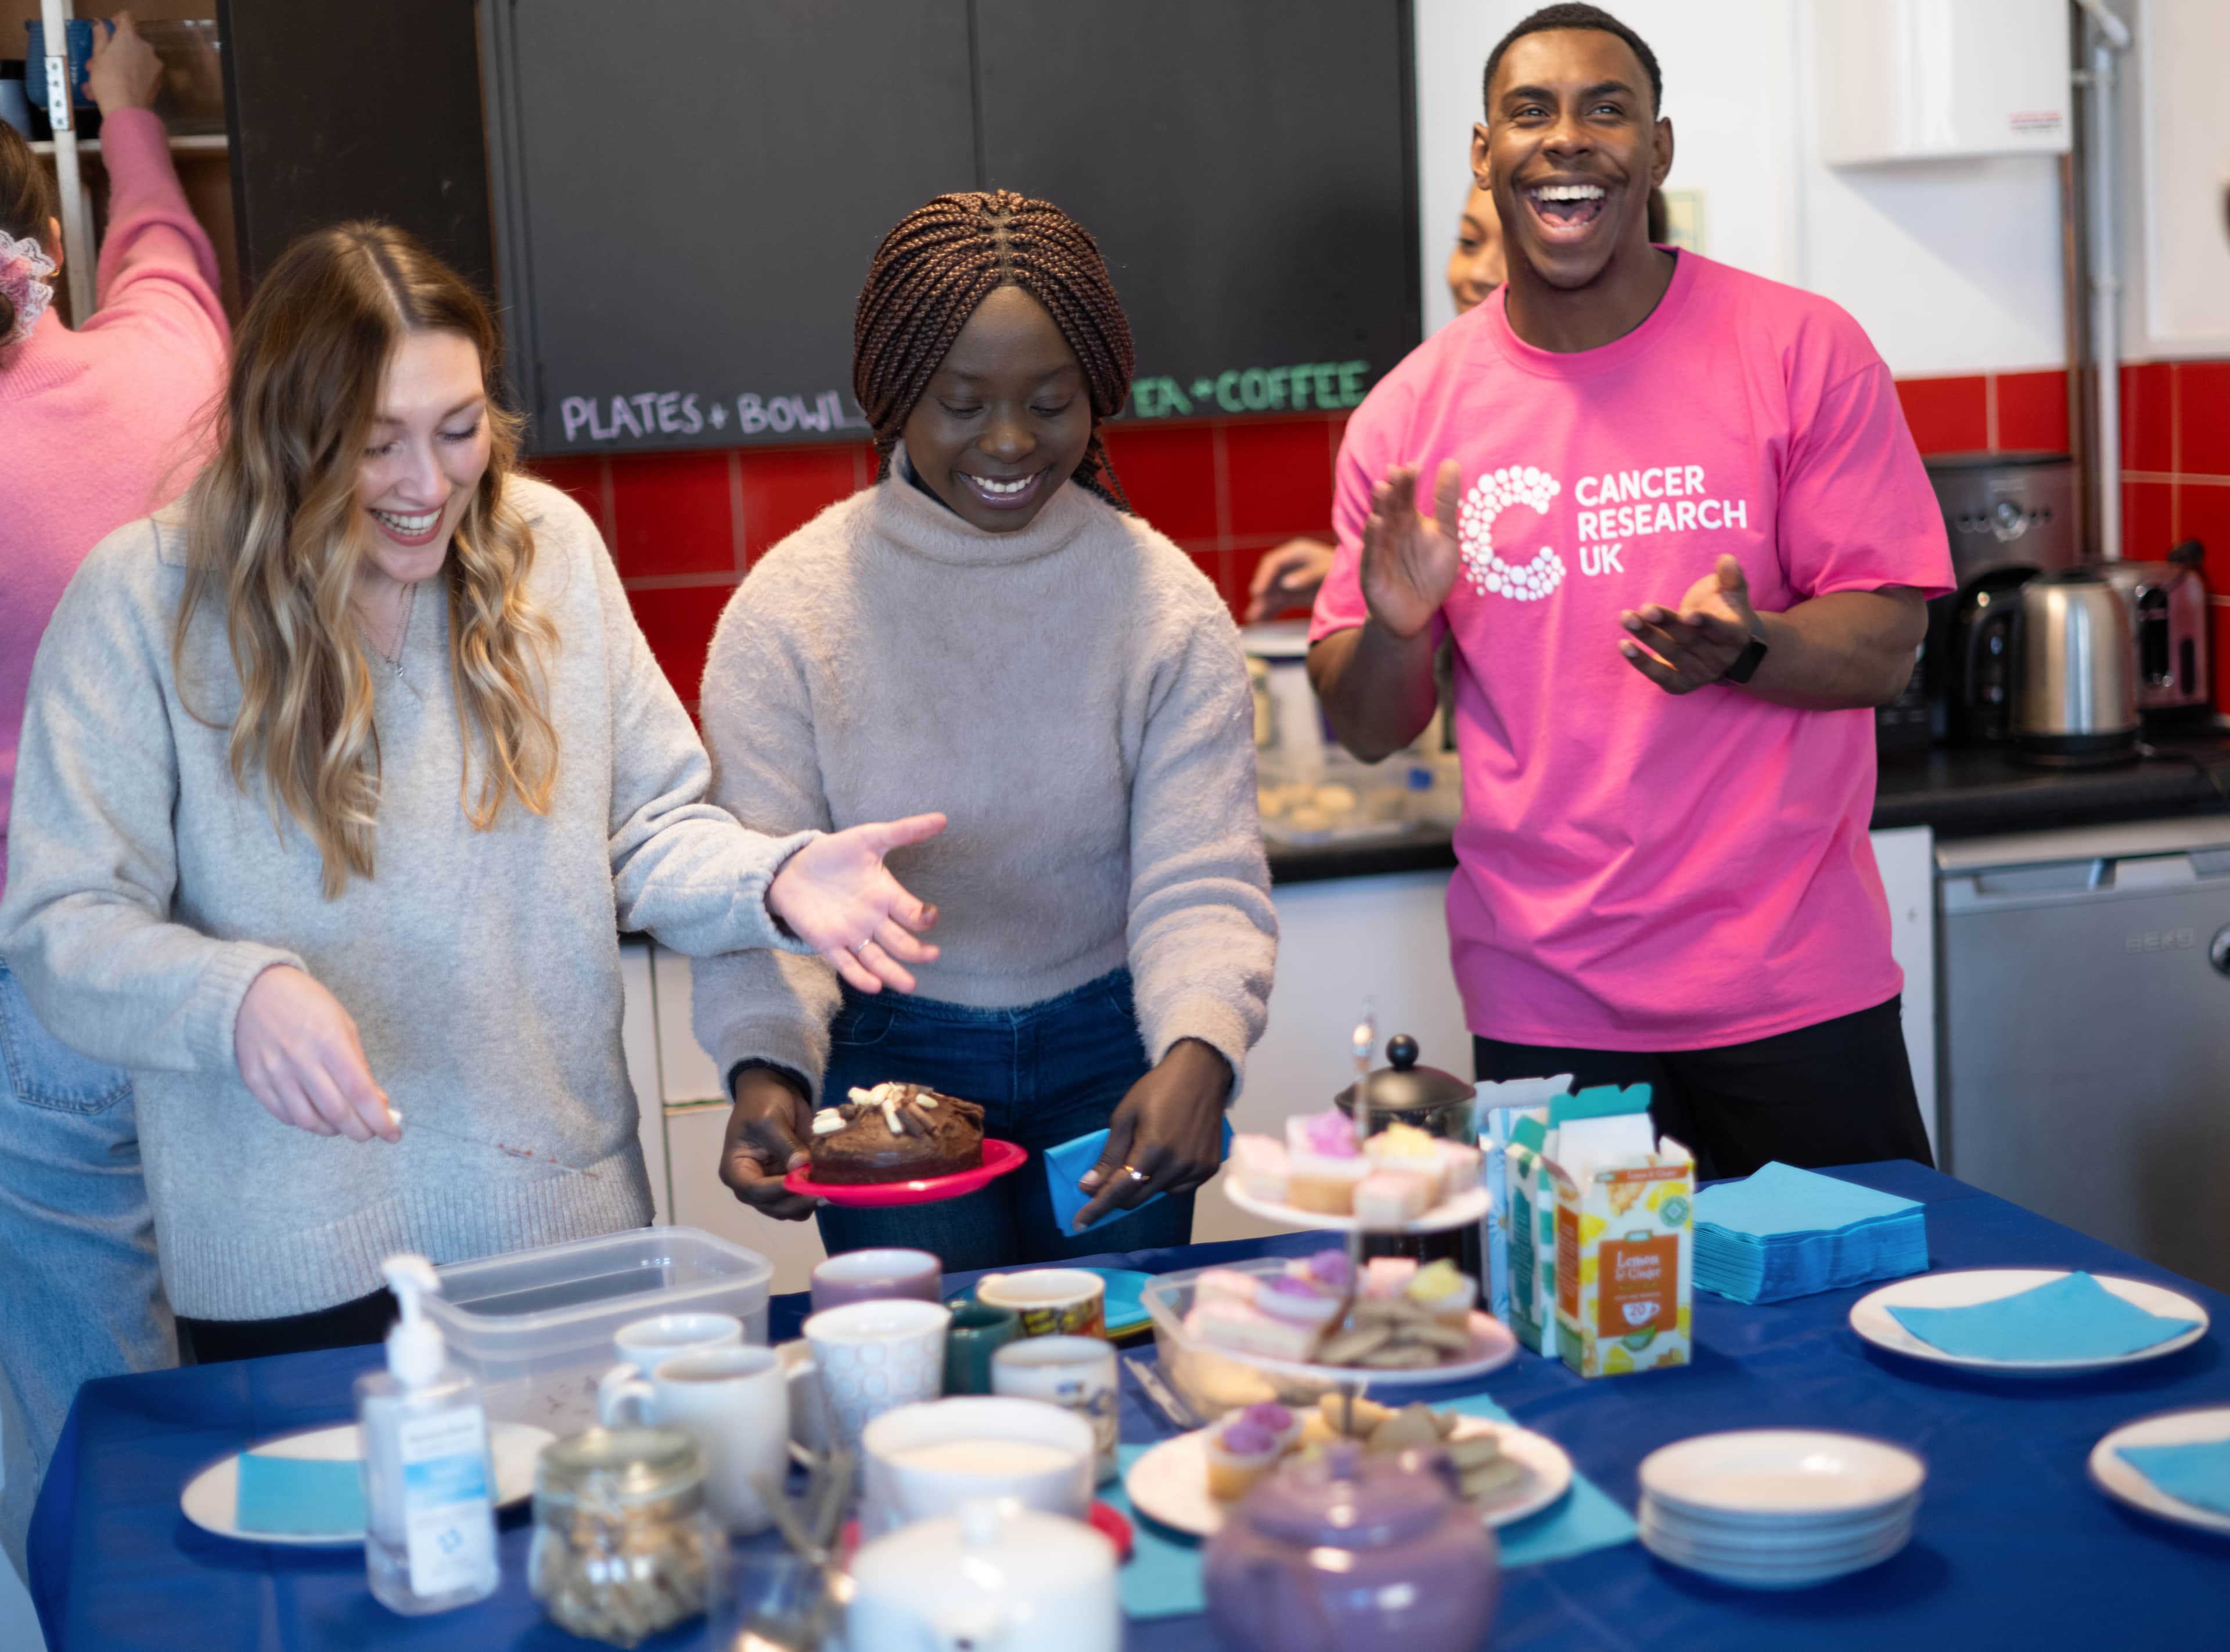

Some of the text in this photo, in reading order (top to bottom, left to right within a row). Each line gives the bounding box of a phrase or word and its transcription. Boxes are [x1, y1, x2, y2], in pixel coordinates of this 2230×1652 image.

[1114, 375, 1194, 419] EA
[1215, 359, 1371, 412] COFFEE
[561, 391, 704, 441] PLATES
[1574, 465, 1706, 507] CANCER
[1577, 499, 1747, 542] RESEARCH
[1579, 544, 1624, 577] UK
